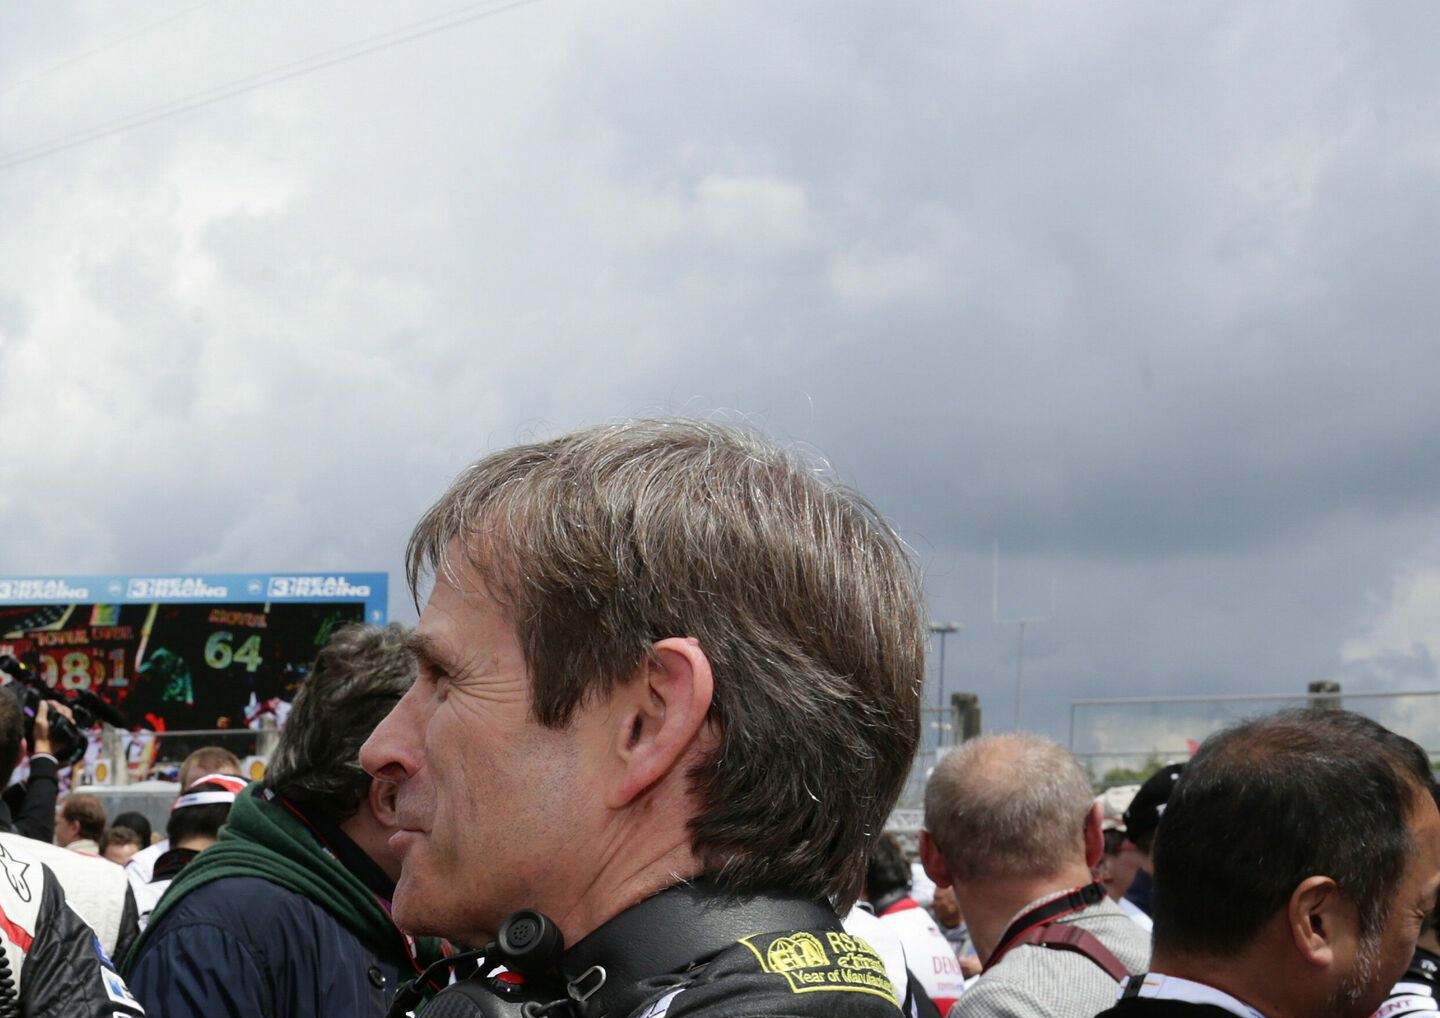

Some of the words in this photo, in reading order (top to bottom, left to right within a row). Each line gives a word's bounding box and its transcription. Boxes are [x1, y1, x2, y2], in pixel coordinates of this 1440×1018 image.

[294, 576, 345, 586] REAL
[14, 588, 89, 599] RACING
[153, 585, 228, 598] RACING
[293, 584, 371, 597] RACING
[204, 630, 263, 673] 64
[792, 969, 825, 984] Year
[827, 969, 841, 983] of
